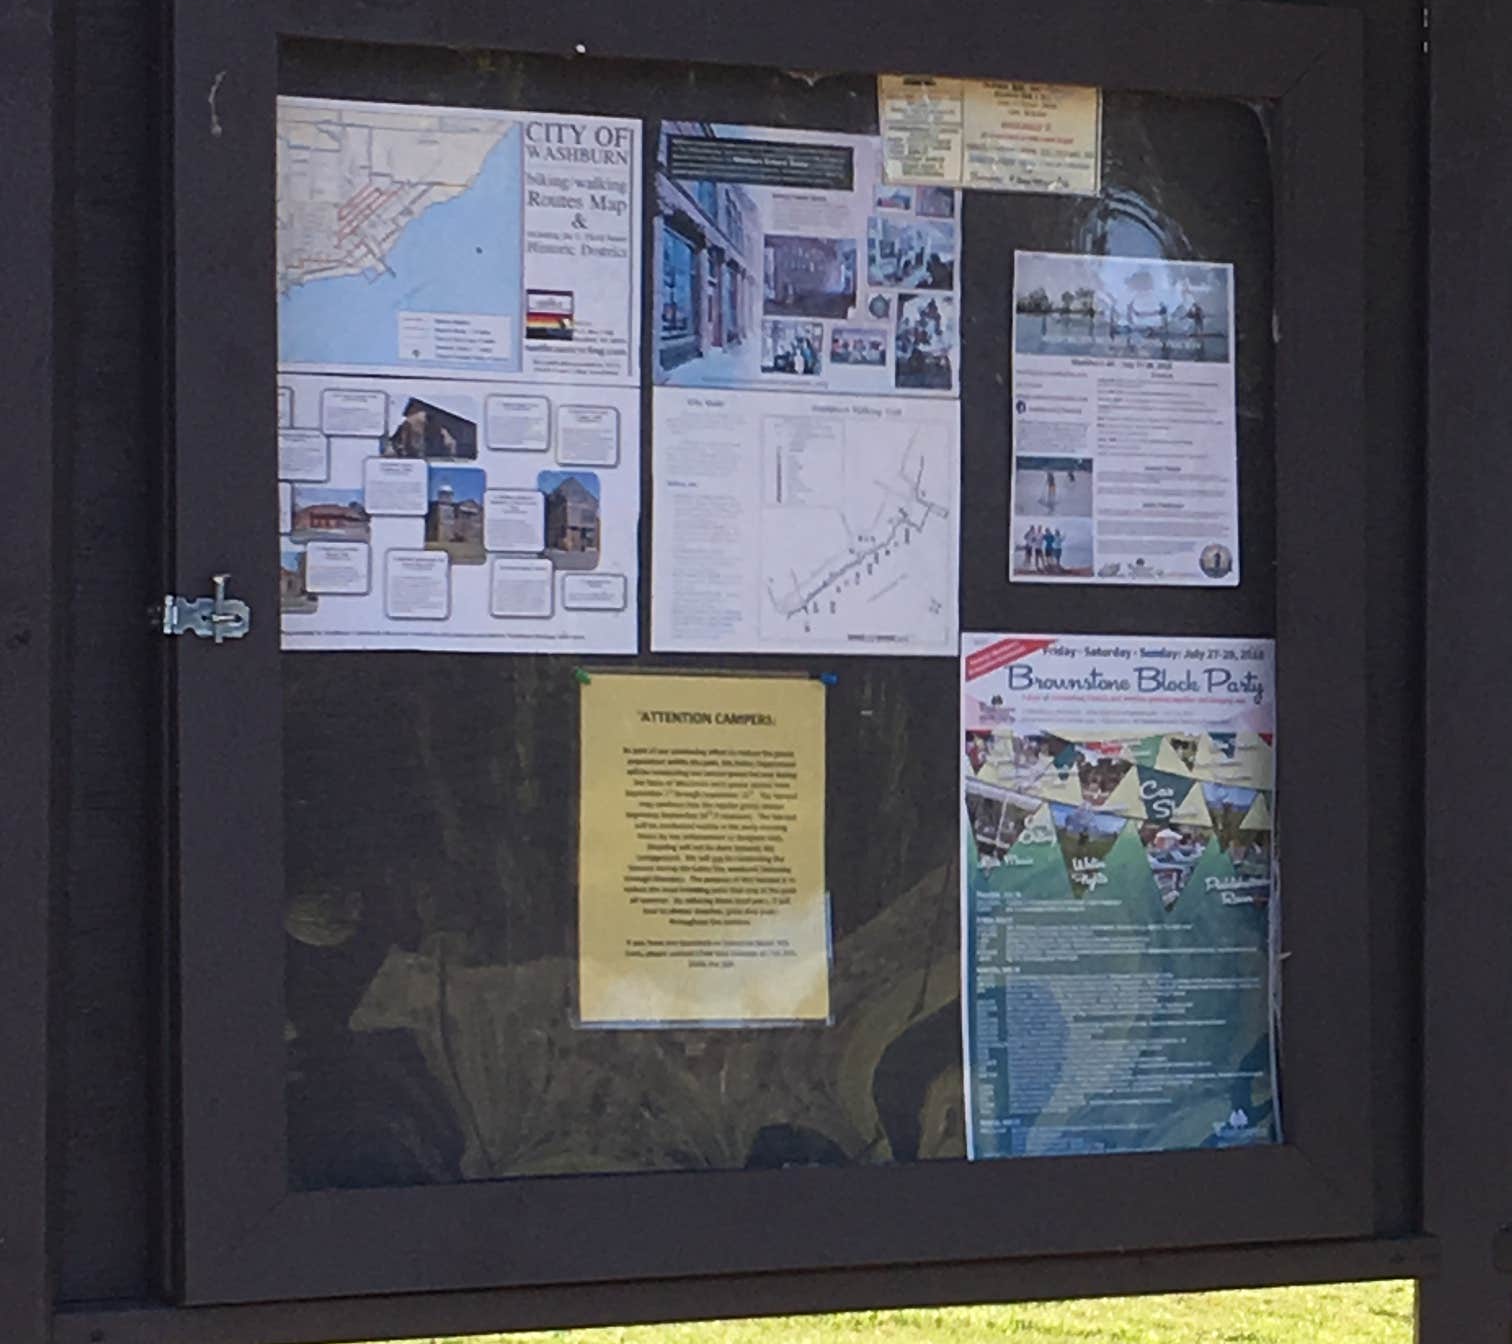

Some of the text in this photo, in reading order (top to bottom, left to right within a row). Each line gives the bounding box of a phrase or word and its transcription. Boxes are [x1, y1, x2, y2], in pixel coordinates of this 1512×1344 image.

[526, 121, 628, 147] CITY OF
[526, 145, 628, 165] WASHBURN
[528, 190, 627, 216] Routes Map
[571, 212, 588, 229] &
[1084, 646, 1131, 659] Saturday
[1184, 648, 1205, 661] July
[1006, 663, 1264, 705] Brownstone Block Party
